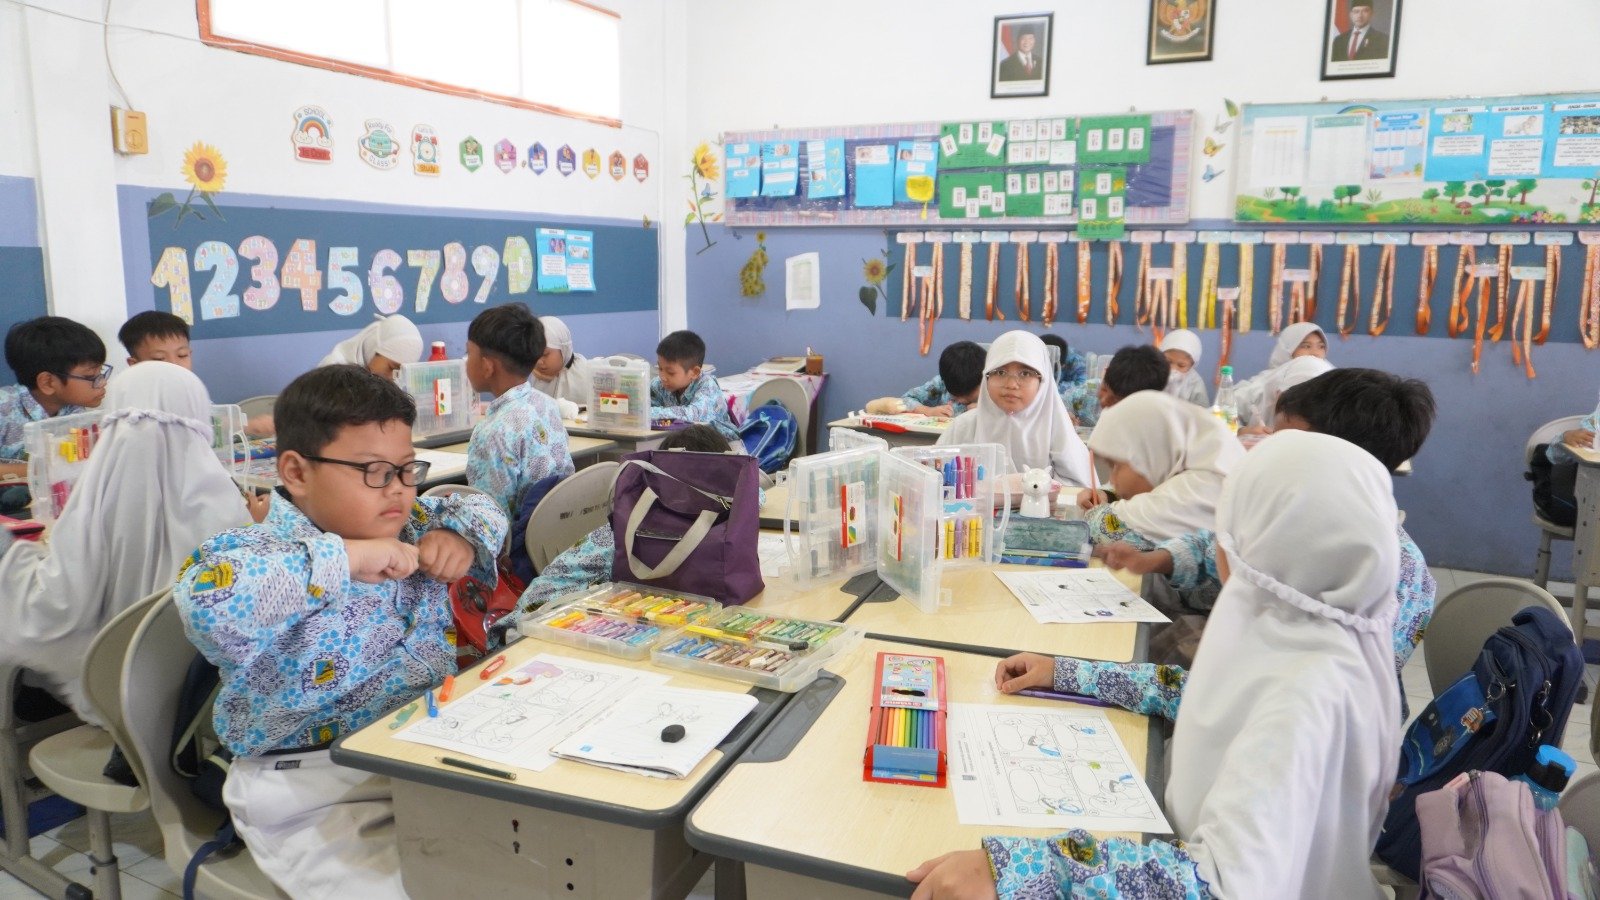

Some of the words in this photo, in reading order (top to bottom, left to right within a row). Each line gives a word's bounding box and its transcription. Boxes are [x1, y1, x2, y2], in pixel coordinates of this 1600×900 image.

[303, 107, 325, 119] SCHOOL
[151, 247, 194, 326] 1
[194, 241, 240, 320] 2
[238, 235, 281, 311] 3
[281, 239, 322, 311] 4
[327, 246, 364, 316] 5
[369, 249, 404, 315] 6
[407, 249, 441, 313] 7
[440, 242, 469, 304] 8
[471, 245, 500, 303] 9
